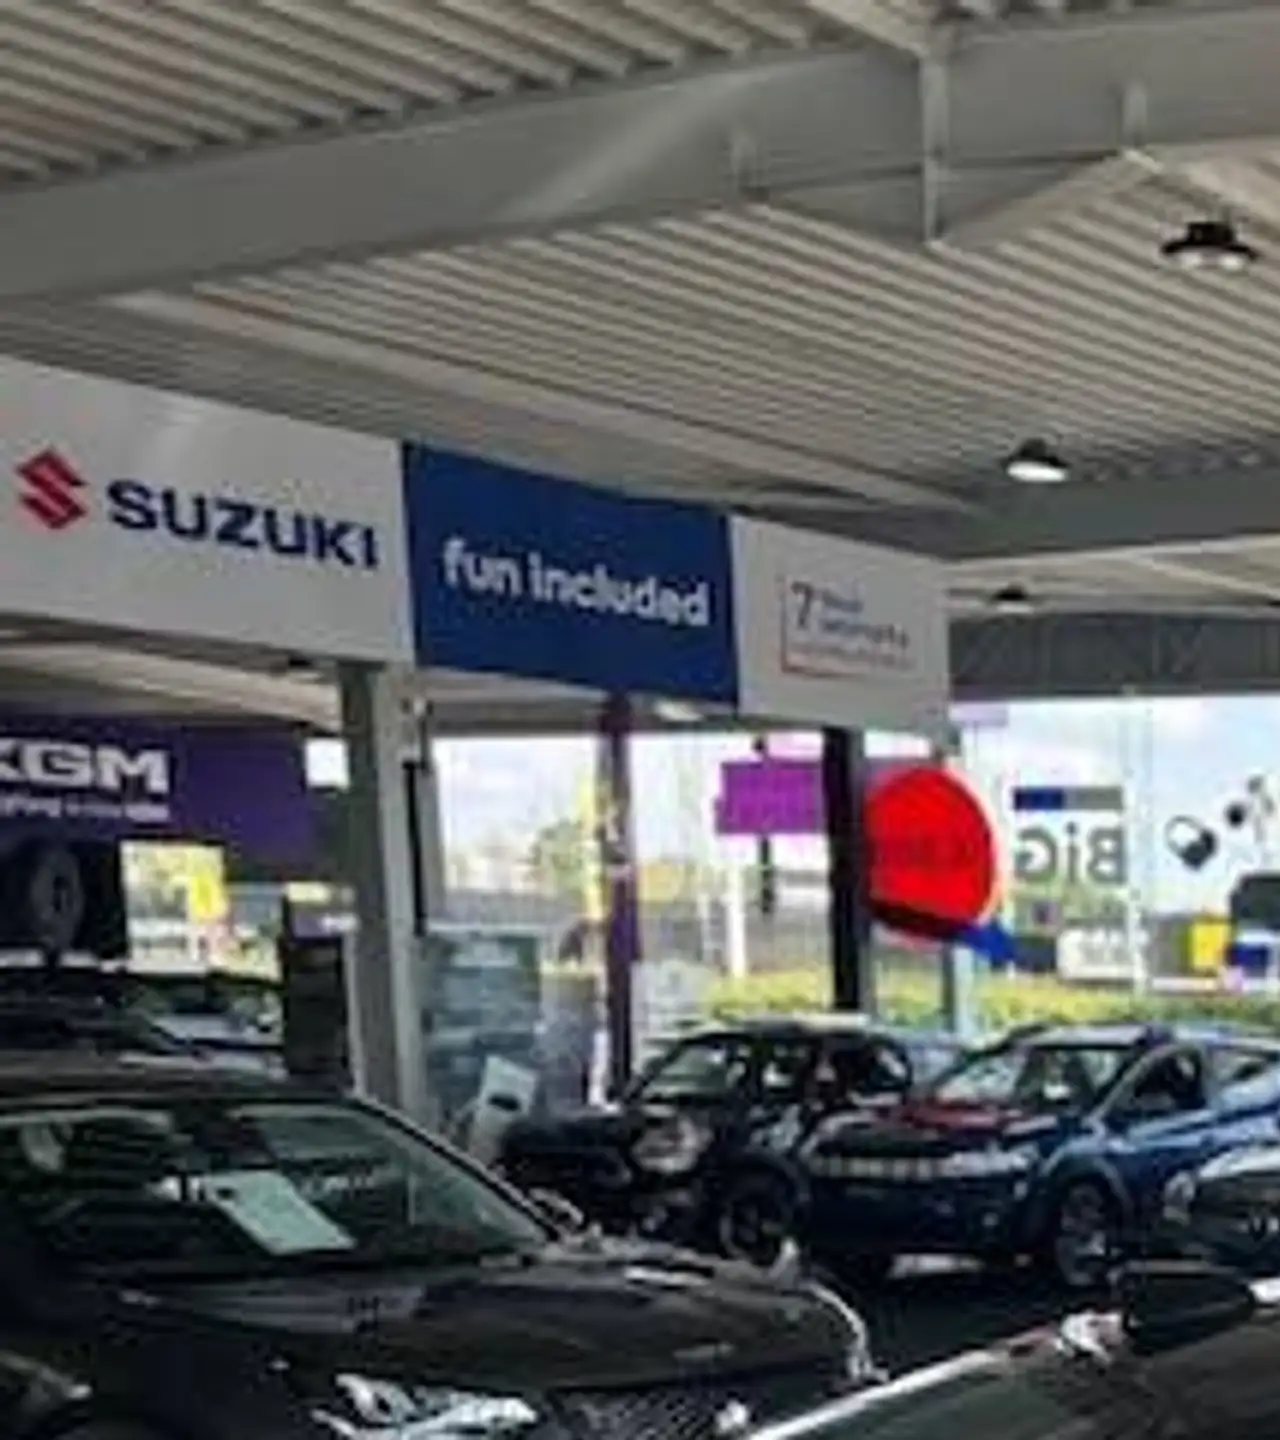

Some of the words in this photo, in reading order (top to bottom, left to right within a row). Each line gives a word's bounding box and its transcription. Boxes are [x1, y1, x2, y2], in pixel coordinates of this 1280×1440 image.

[106, 479, 379, 568] SUZUKI
[442, 536, 523, 598] fun
[527, 551, 710, 627] included
